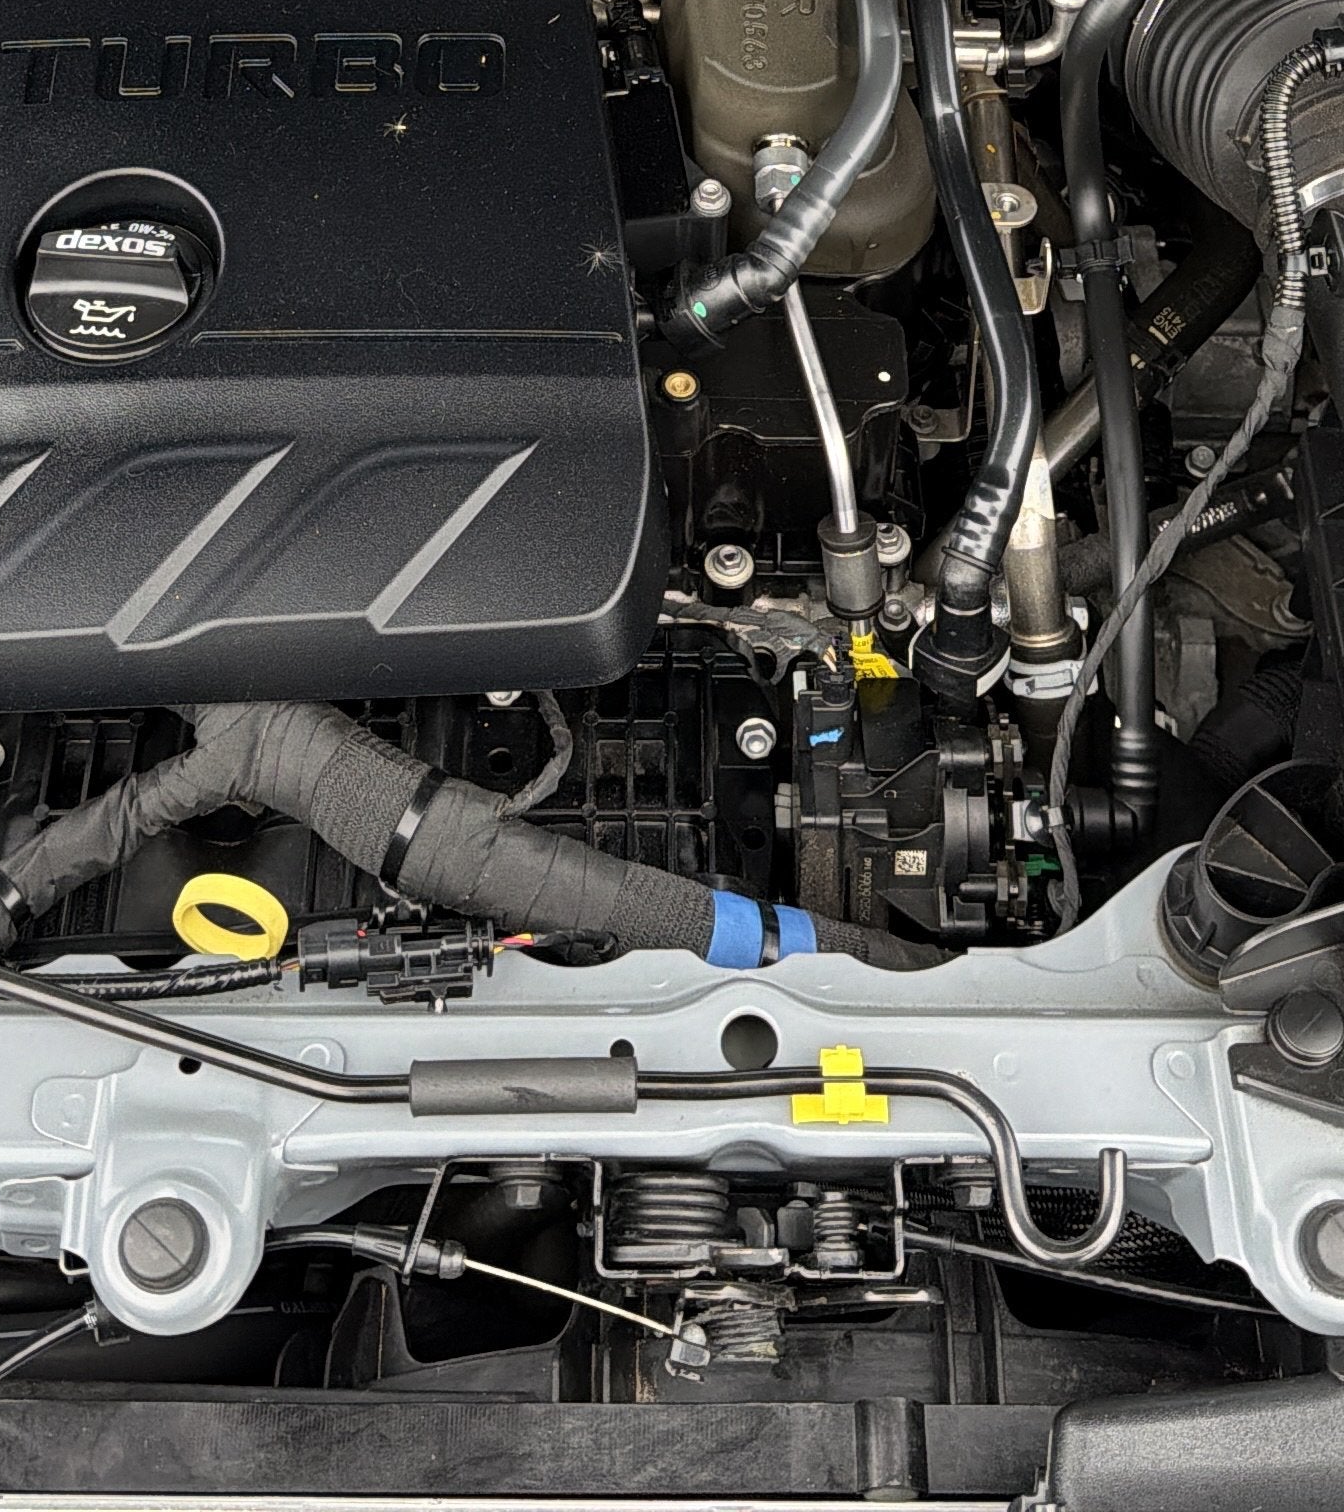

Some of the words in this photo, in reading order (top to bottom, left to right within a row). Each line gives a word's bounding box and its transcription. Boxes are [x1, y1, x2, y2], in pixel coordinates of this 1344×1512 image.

[0, 32, 507, 106] TURBO
[55, 229, 167, 257] dexos
[1153, 314, 1179, 339] ENG
